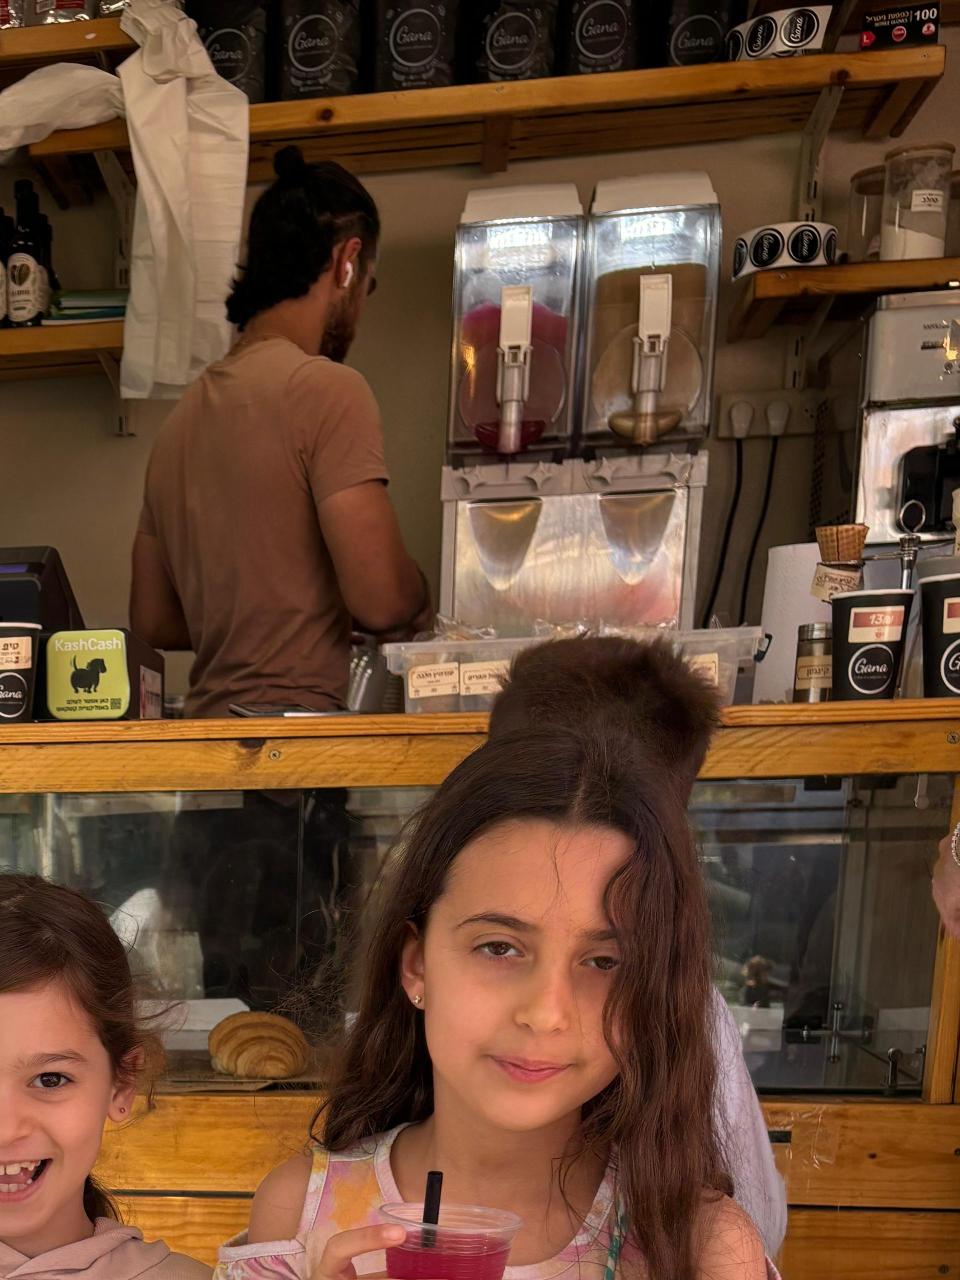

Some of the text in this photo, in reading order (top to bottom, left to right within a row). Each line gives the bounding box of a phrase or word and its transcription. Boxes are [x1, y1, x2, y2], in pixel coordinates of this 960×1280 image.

[914, 7, 938, 21] 100
[55, 636, 122, 652] KashCash
[854, 657, 888, 674] Gana
